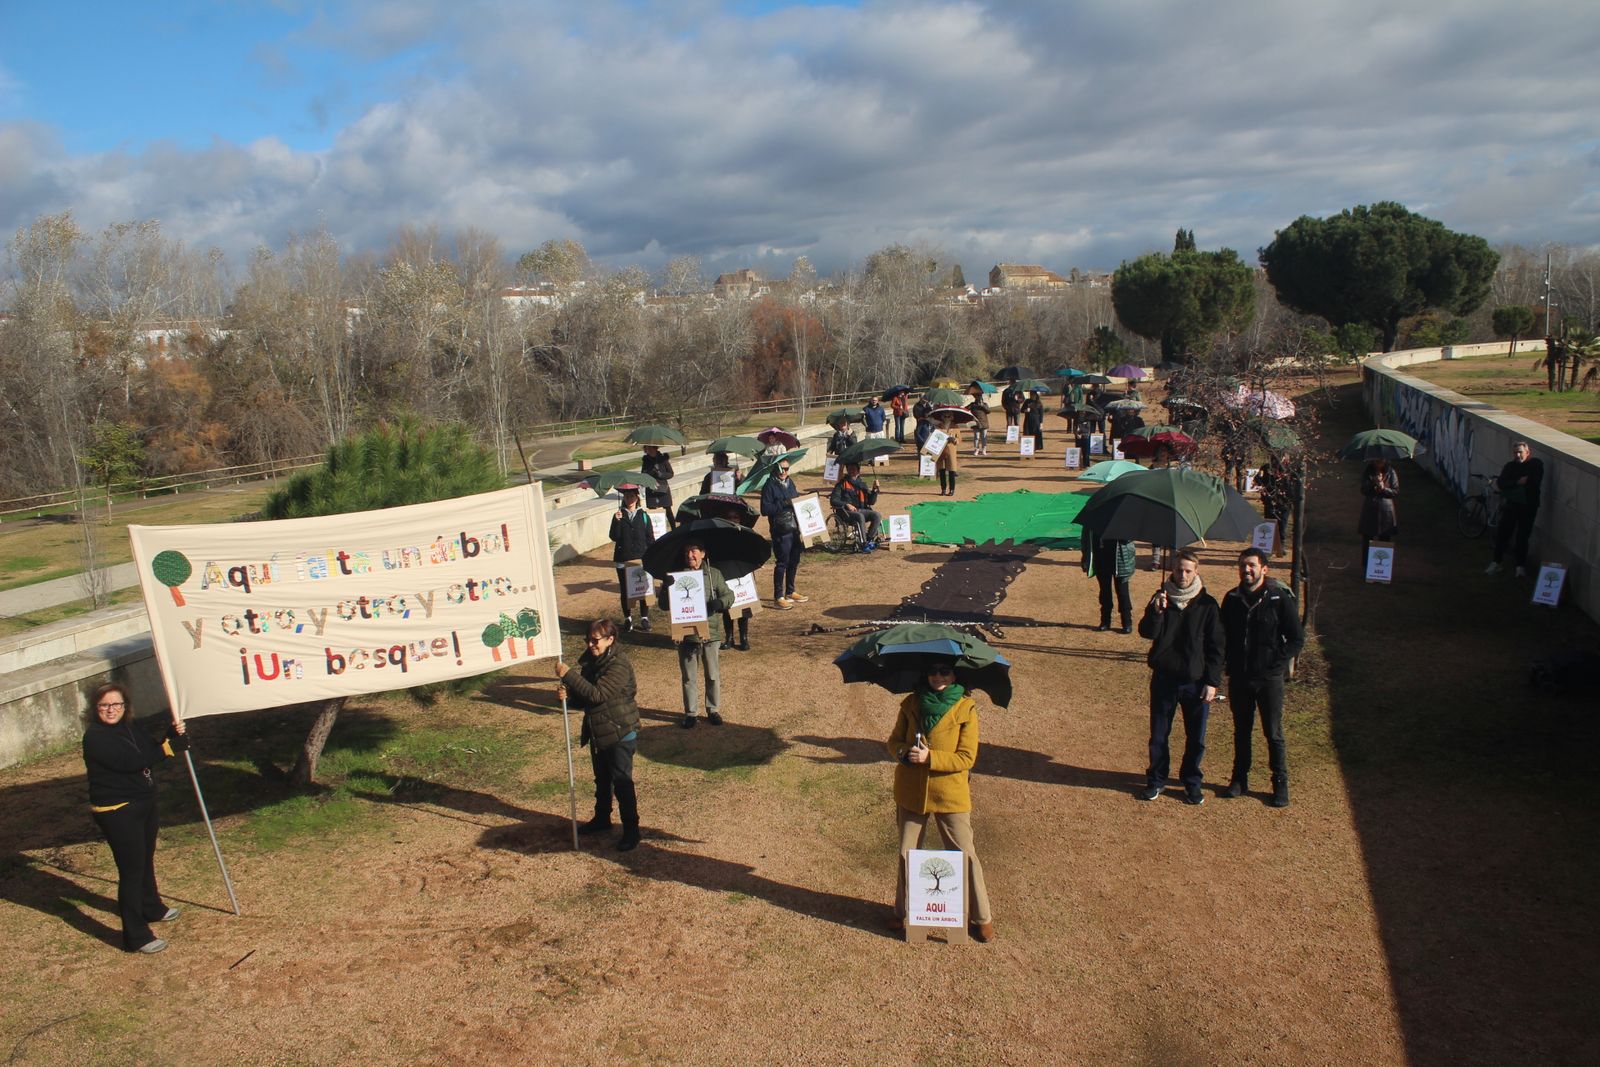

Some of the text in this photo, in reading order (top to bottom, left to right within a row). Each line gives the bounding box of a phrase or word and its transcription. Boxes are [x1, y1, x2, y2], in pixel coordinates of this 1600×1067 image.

[201, 524, 510, 593] Aquí falta un árbol
[181, 618, 203, 649] y
[240, 631, 463, 685] ¡Un bosque!
[926, 901, 946, 912] AQUÍ
